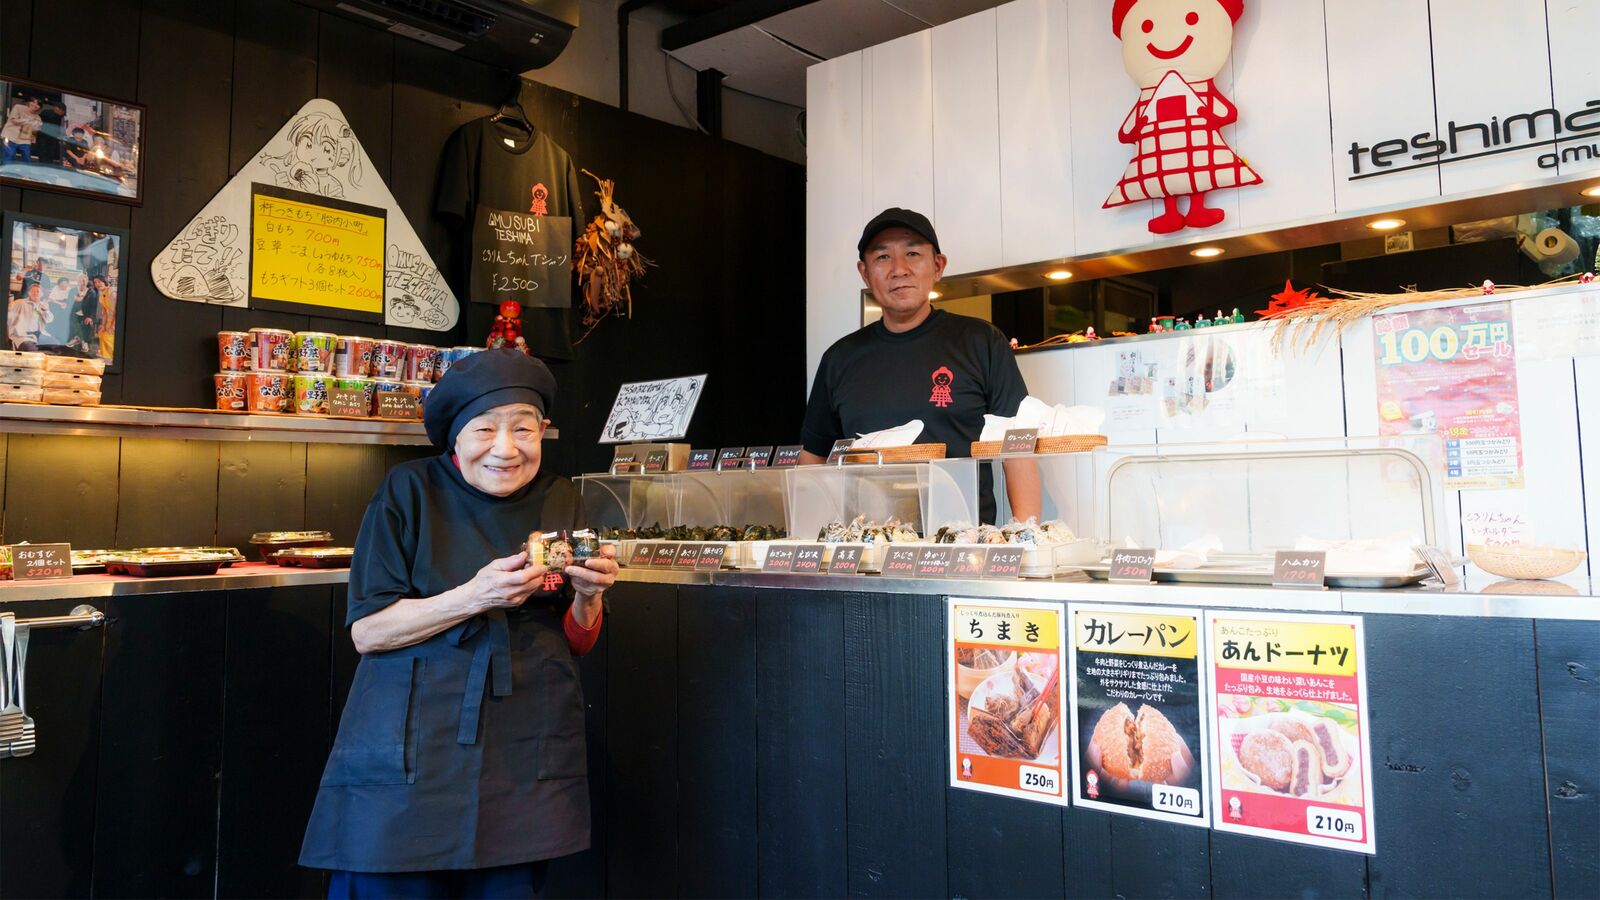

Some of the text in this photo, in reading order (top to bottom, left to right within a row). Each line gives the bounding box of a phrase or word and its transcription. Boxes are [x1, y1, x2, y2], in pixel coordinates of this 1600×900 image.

[1537, 143, 1600, 170] am
[266, 222, 341, 248] 白もち 700円
[495, 228, 534, 245] TESHIMA
[356, 255, 383, 271] 750円
[493, 273, 539, 292] ¥2500
[347, 285, 383, 302] 2600円
[1460, 341, 1513, 361] セール
[216, 387, 245, 398] なめこ
[19, 550, 56, 559] おむすび
[892, 551, 914, 561] ひじき
[923, 551, 946, 560] ゆかり
[991, 552, 1021, 562] わさび
[27, 558, 66, 567] 2個セット
[832, 561, 857, 570] 200円
[889, 562, 913, 570] 200円
[920, 565, 945, 574] 200円
[989, 564, 1017, 573] 200円
[1281, 558, 1321, 568] ハムカツ
[26, 567, 63, 577] 520円
[1116, 566, 1147, 577] 150円
[970, 618, 1040, 643] ちまき
[1083, 617, 1192, 649] カレーパン
[1221, 626, 1279, 637] あんこたっぷり
[1222, 639, 1350, 668] あんドーナツ
[1240, 673, 1336, 689] 国産小豆の味わい深いあんこを
[1106, 689, 1165, 703] こだわりのカレーパンです。
[1224, 683, 1354, 703] たっぷり包み、生地をふっくら仕上げました。
[1025, 773, 1054, 788] 250円
[1159, 792, 1193, 809] 210円
[1315, 815, 1355, 834] 210円
